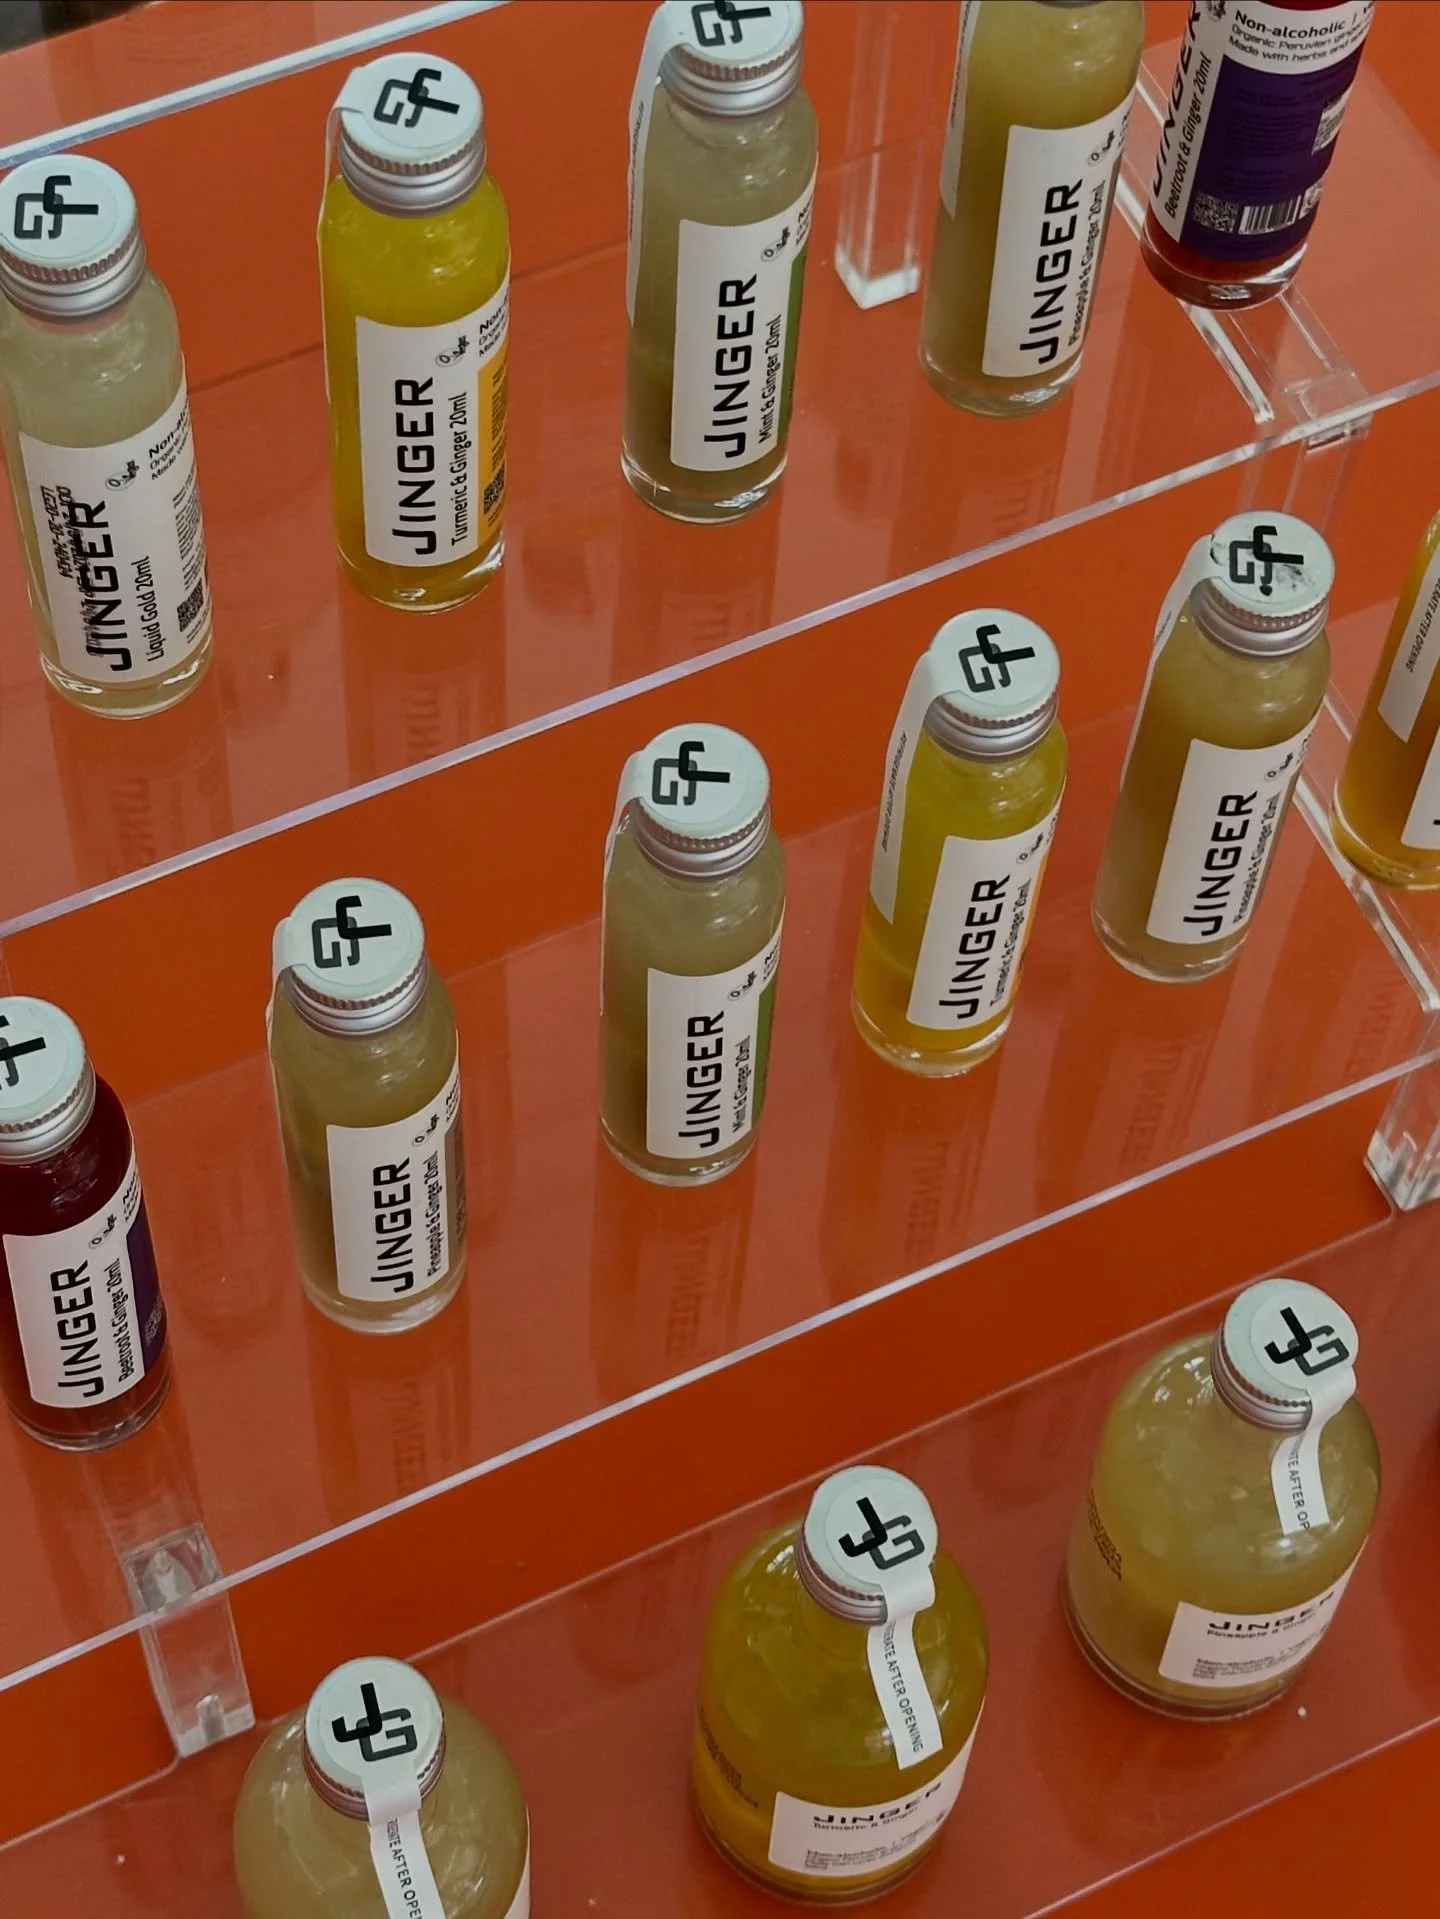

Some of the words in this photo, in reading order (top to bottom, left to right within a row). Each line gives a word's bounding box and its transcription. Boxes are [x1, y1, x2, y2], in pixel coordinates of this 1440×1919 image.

[1231, 23, 1276, 49] Organic
[1279, 38, 1331, 51] Peruvian
[1234, 9, 1346, 39] Non-alcoholic
[1229, 35, 1259, 56] Made
[1262, 48, 1289, 62] with
[1193, 50, 1212, 95] 20ml
[1182, 93, 1202, 142] Ginger
[1179, 141, 1191, 157] &
[1164, 153, 1190, 219] Beetroot
[1018, 178, 1083, 365] JINGER
[765, 314, 781, 354] 20ml
[703, 273, 758, 459] JINGER
[762, 353, 780, 399] Ginger
[448, 391, 468, 429] 20ml
[758, 409, 774, 444] Mint
[760, 396, 775, 412] &
[391, 376, 437, 556] JINGER
[450, 430, 472, 474] Ginger
[450, 472, 468, 487] &
[450, 485, 468, 546] Turmeric
[67, 500, 133, 672] JINGER
[130, 555, 154, 592] 20ml
[136, 590, 158, 622] Gold
[141, 621, 166, 662] Liquid
[1183, 790, 1258, 937] JINGER
[938, 874, 1011, 1021] JINGER
[678, 1010, 724, 1149] JINGER
[370, 1157, 415, 1294] JINGER
[51, 1259, 105, 1399] JINGER
[112, 1287, 129, 1327] Ginger
[114, 1330, 135, 1383] Beetroot
[1288, 1470, 1305, 1509] AFTER
[886, 1660, 906, 1698] AFTER
[899, 1698, 924, 1753] OPENING
[391, 1848, 412, 1889] AFTER
[404, 1889, 422, 1919] OPE
